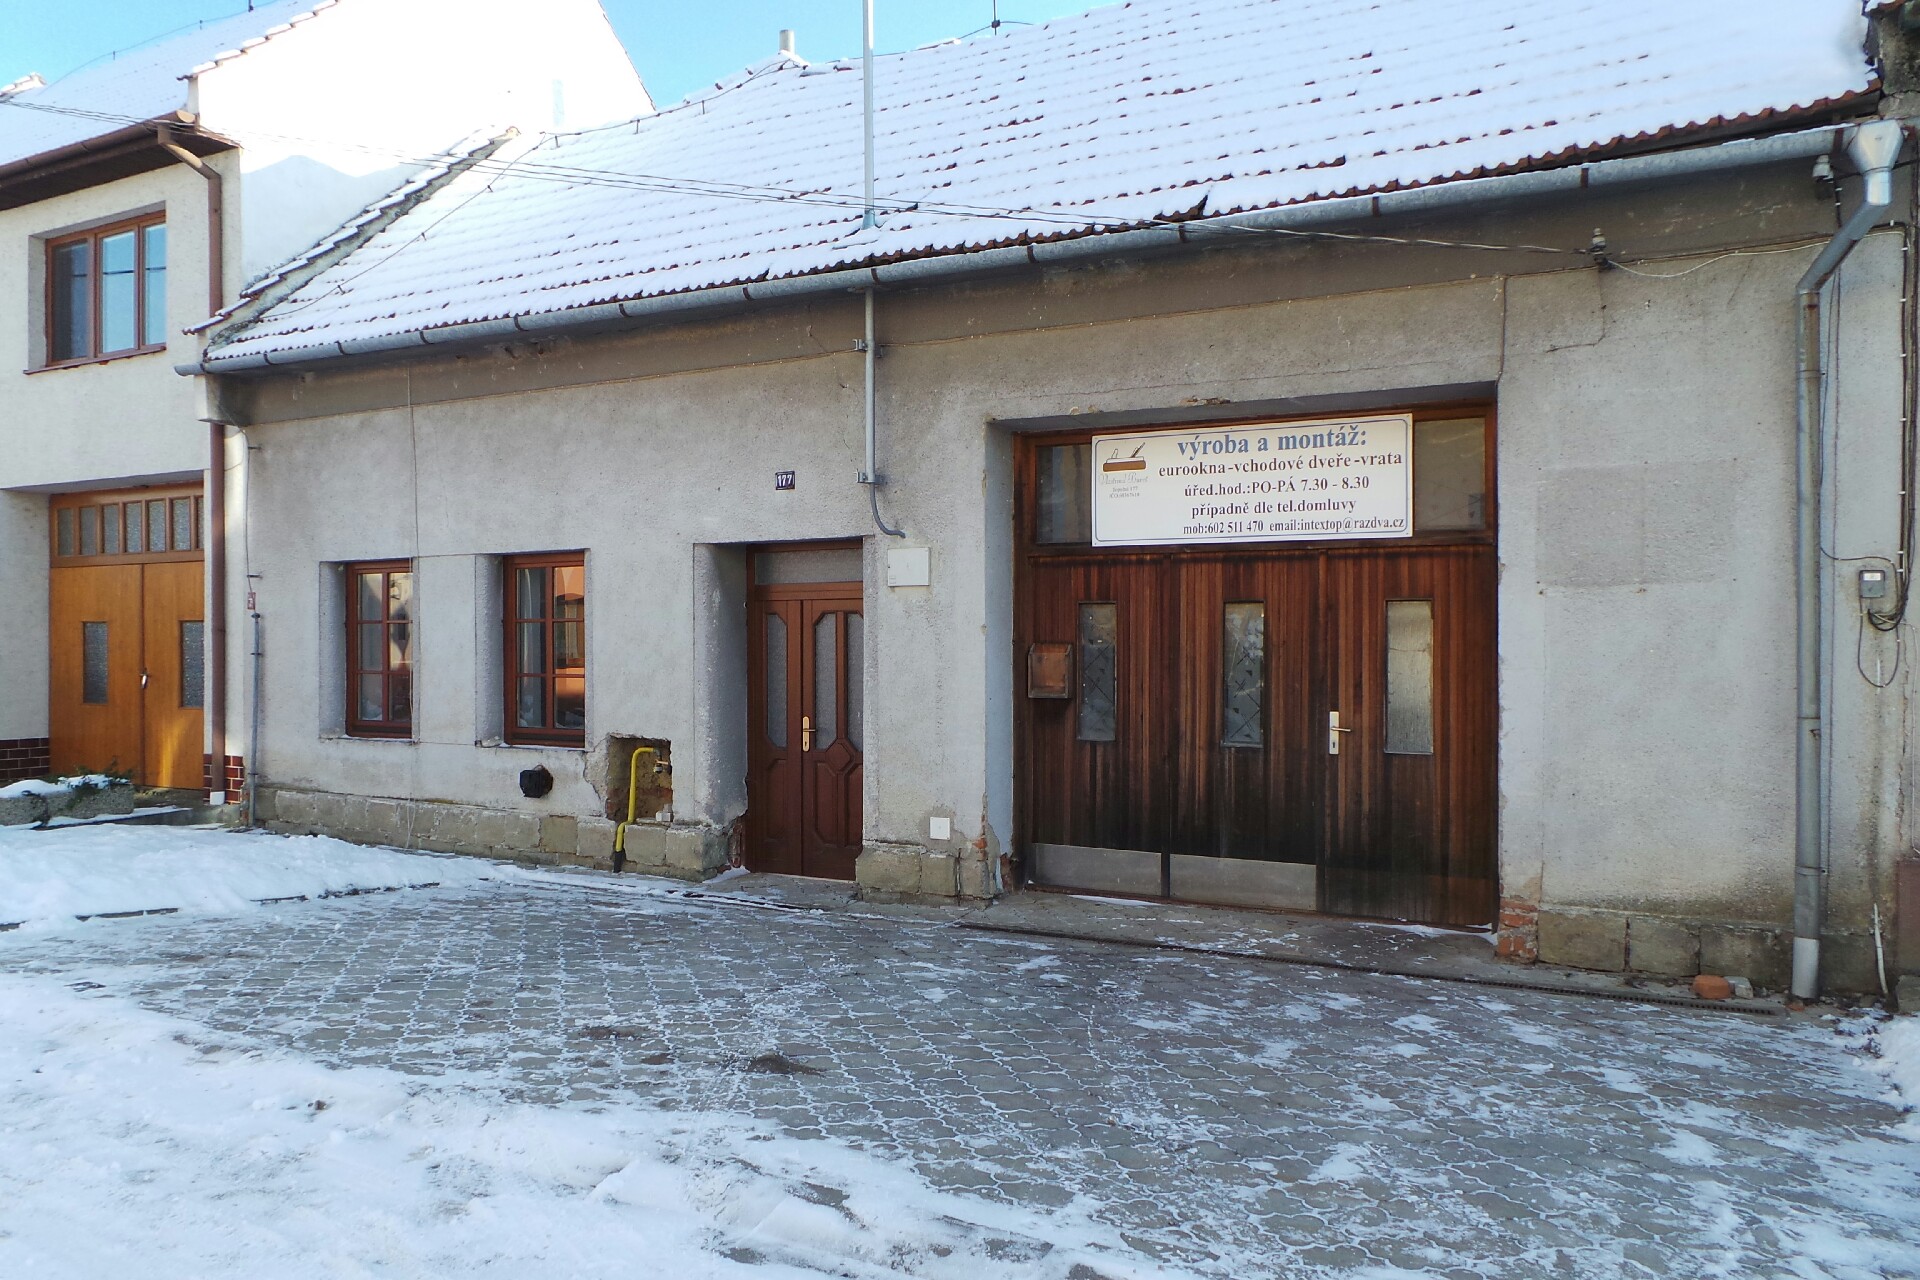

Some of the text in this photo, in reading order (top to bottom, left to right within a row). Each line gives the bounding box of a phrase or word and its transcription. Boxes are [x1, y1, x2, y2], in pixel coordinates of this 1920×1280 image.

[1177, 424, 1367, 461] výroba a montáž:
[777, 474, 793, 487] 177
[1300, 477, 1328, 492] 7.30
[1341, 475, 1370, 490] 8.30
[1191, 498, 1357, 520] případně dle tel.domluvy
[1227, 521, 1243, 534] 511
[1246, 519, 1264, 533] 470
